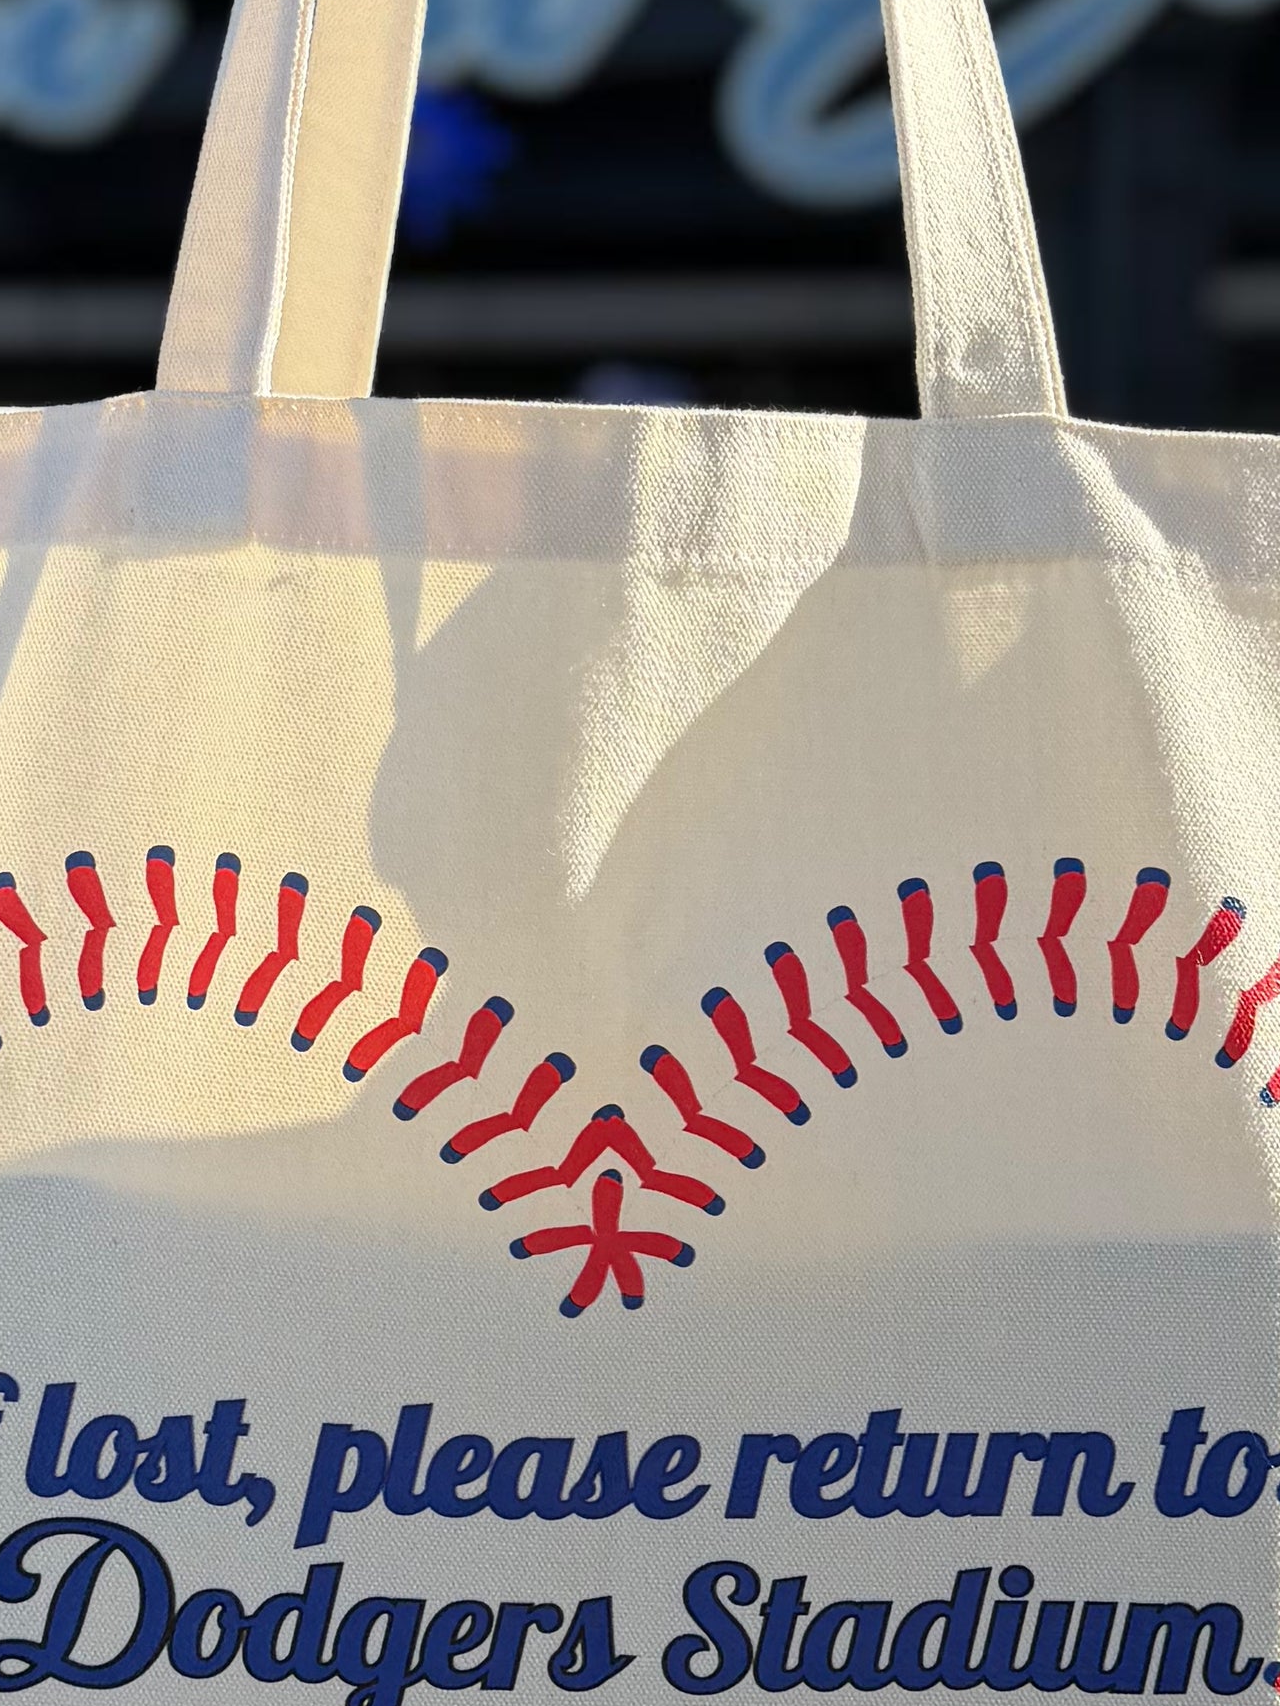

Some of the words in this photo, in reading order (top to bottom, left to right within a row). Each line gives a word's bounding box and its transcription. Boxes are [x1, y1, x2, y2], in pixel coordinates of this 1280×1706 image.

[25, 1382, 276, 1528] lost,
[294, 1403, 709, 1550] please
[724, 1408, 1136, 1520] return
[662, 1560, 1265, 1695] Stadium
